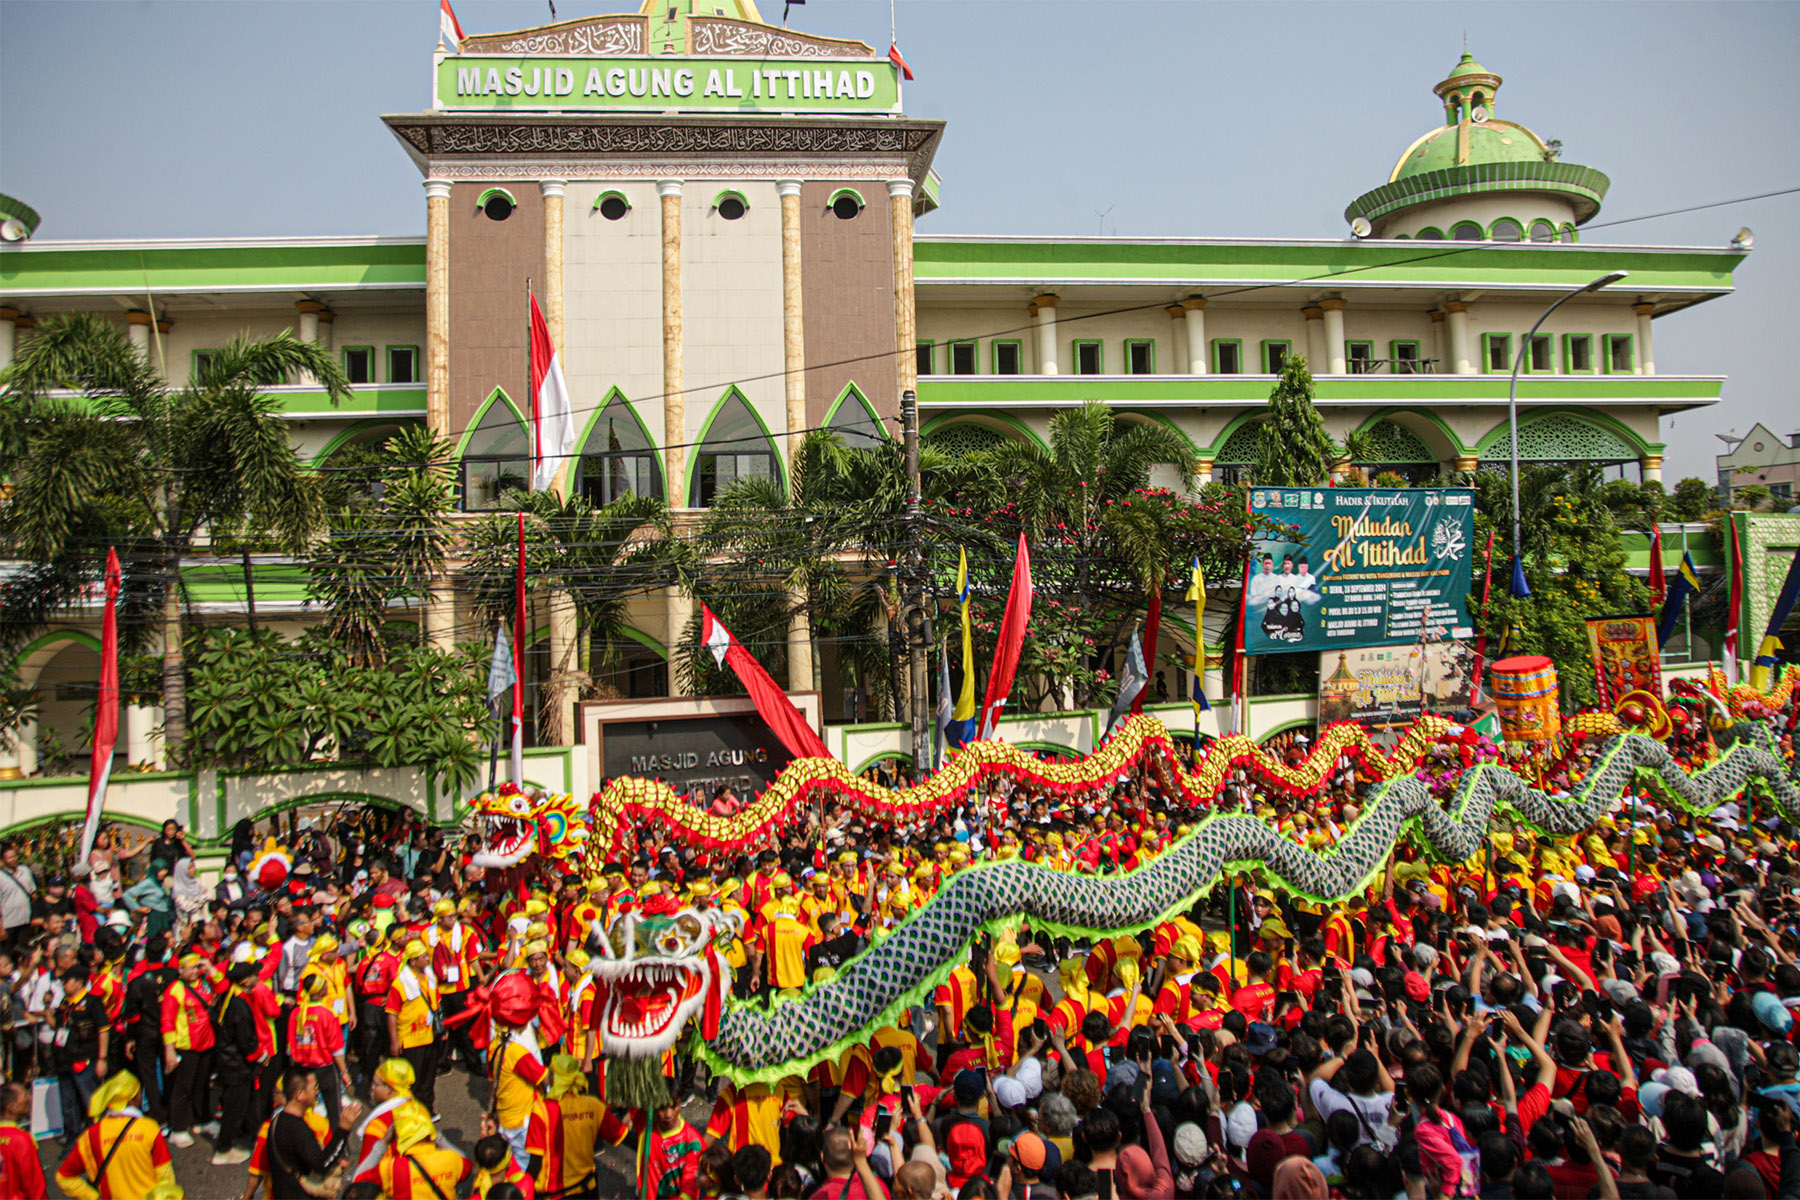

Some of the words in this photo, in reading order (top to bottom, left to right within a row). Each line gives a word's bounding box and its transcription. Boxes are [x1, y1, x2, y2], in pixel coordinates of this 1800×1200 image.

[457, 67, 574, 96] MASJID
[584, 68, 694, 97] AGUNG
[704, 69, 743, 98] AL
[753, 69, 875, 99] ITTIHAD
[1336, 495, 1363, 505] HADIR
[1364, 496, 1371, 505] &
[1323, 540, 1355, 572] Al
[1357, 535, 1428, 568] Ittihad
[631, 752, 698, 772] MASJID
[705, 748, 768, 768] AGUNG
